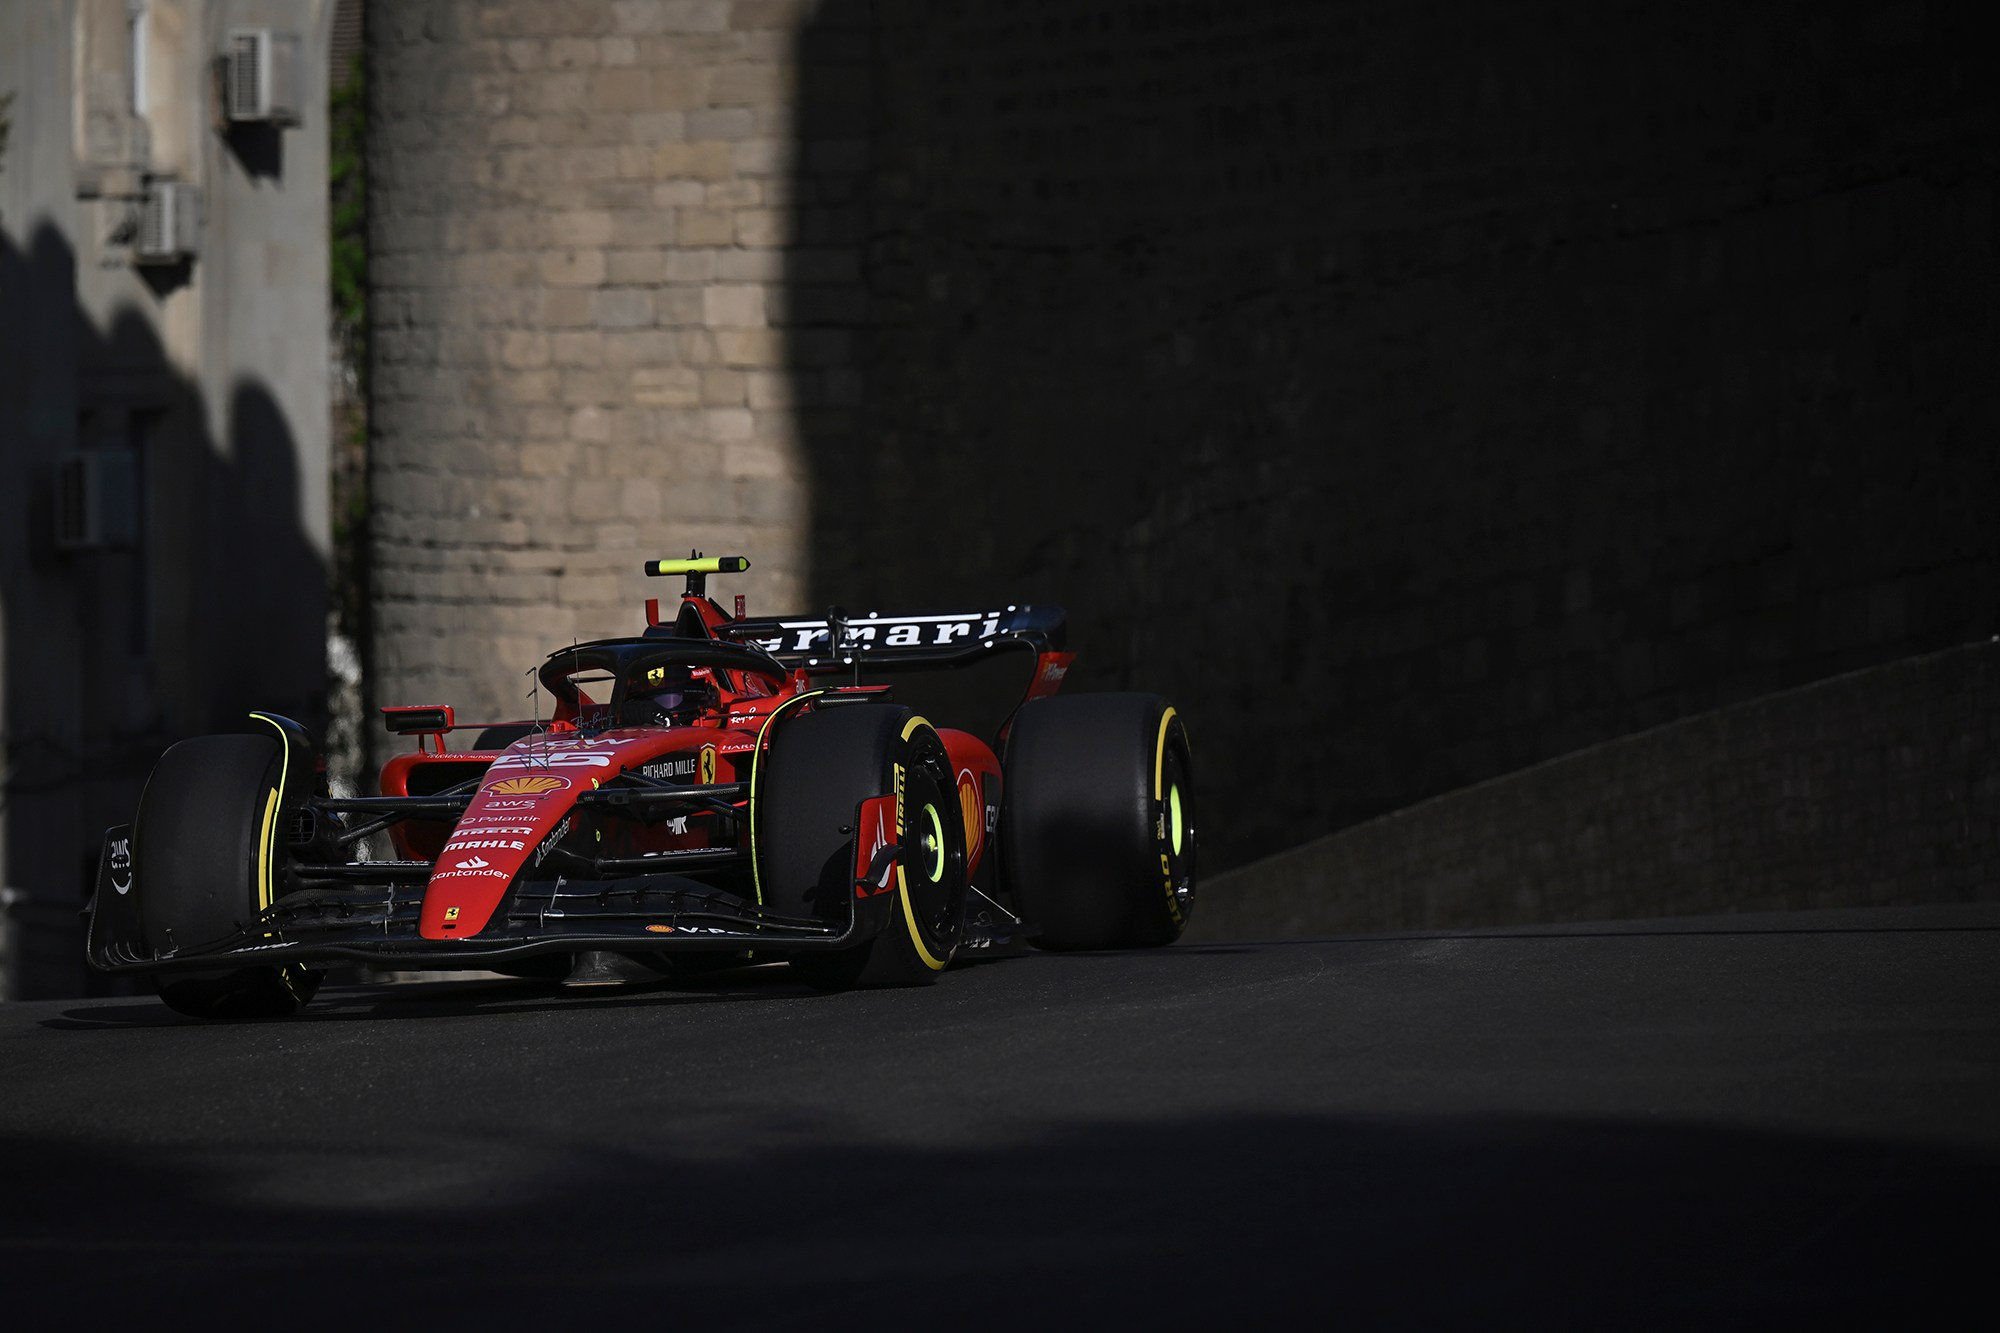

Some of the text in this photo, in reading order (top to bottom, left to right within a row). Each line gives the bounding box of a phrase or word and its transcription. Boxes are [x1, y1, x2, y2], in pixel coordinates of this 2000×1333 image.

[642, 758, 696, 779] RICHARD MILLE
[485, 799, 536, 810] aws
[478, 815, 541, 824] Palantir
[450, 826, 534, 839] PIRELLI
[442, 840, 526, 854] MAHLE
[427, 868, 511, 885] santander
